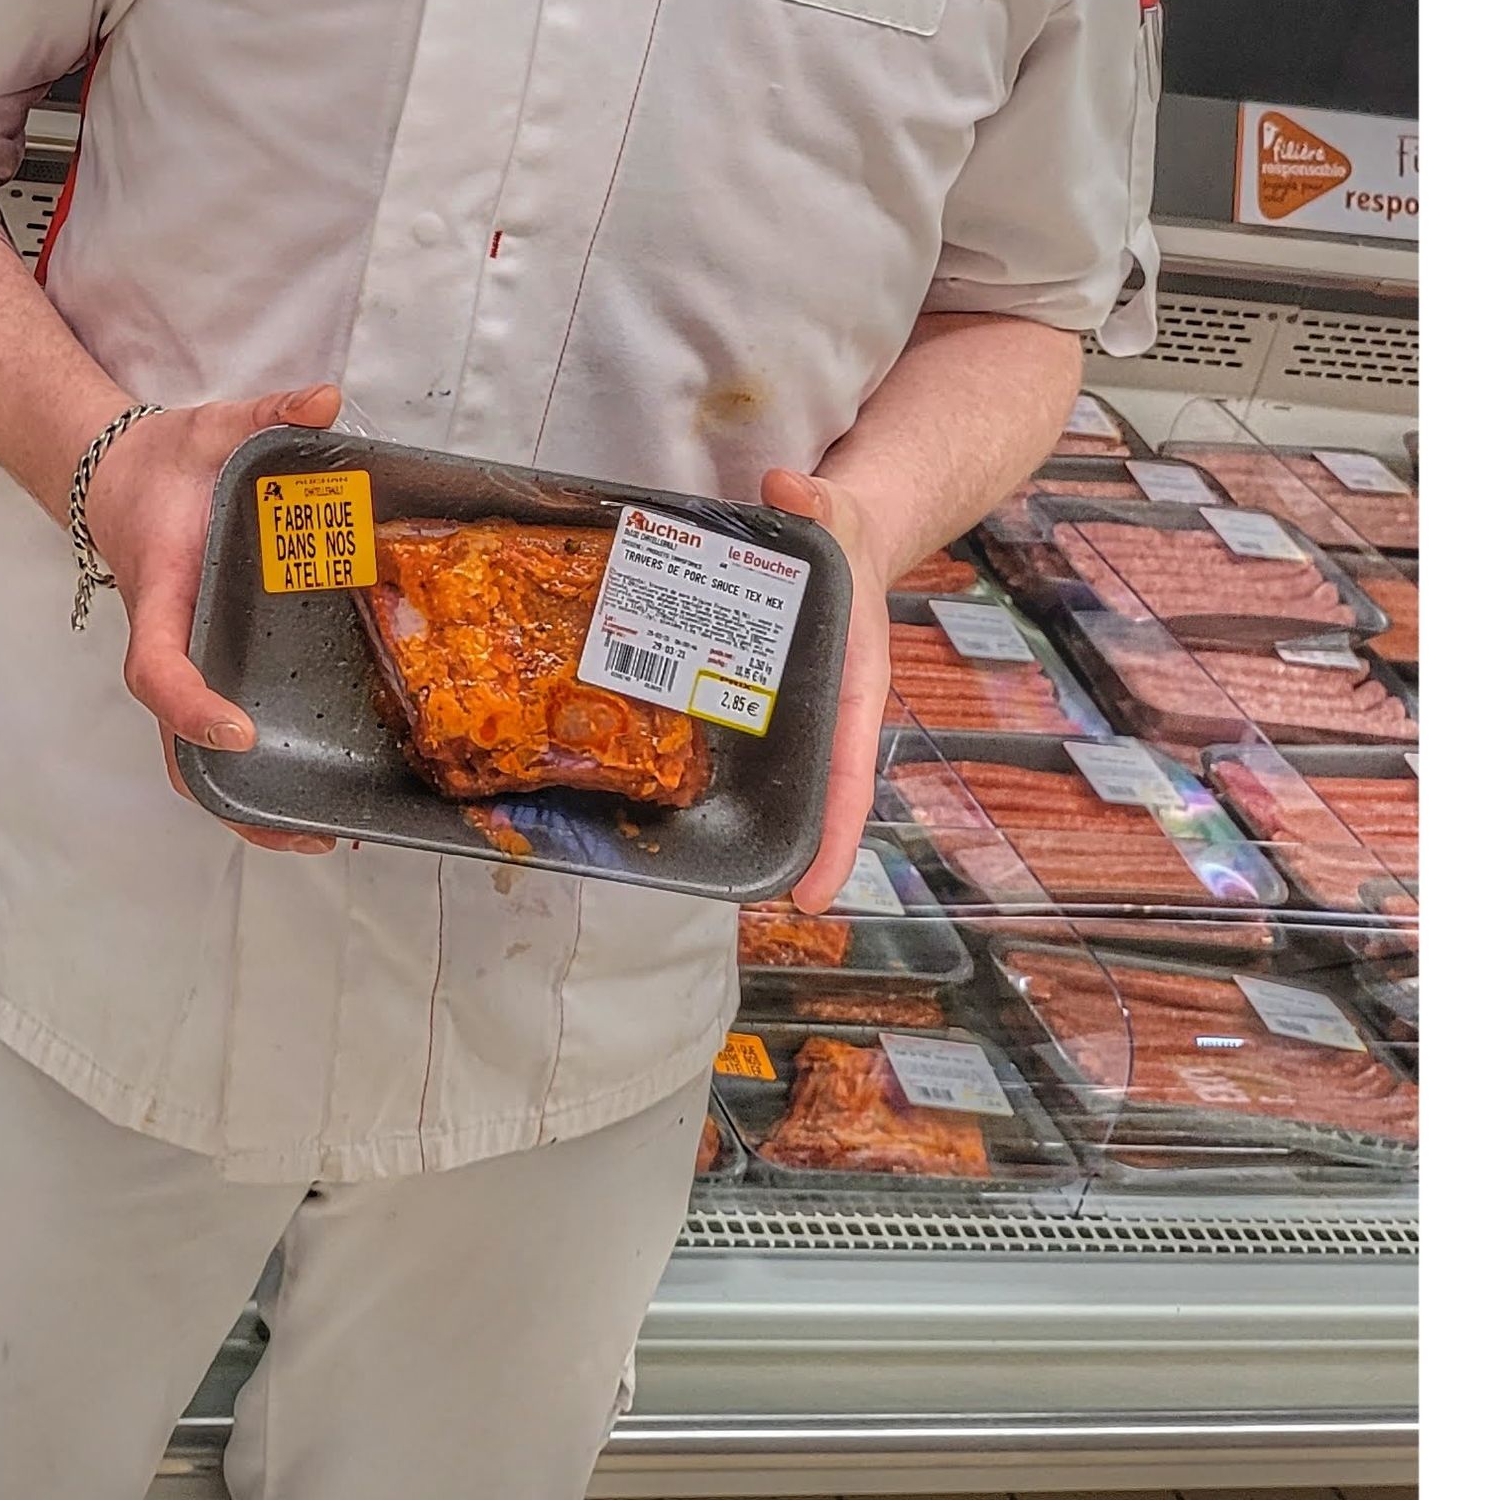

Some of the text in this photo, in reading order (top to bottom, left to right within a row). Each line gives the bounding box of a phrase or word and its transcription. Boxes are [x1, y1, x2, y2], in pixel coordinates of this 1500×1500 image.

[1262, 163, 1347, 179] responsable
[1345, 189, 1419, 221] respo
[273, 501, 354, 532] FABRIQUE
[625, 510, 702, 549] Auchan
[276, 530, 356, 561] DANS NOS
[285, 559, 354, 589] ATELIER
[728, 545, 741, 561] le
[743, 550, 802, 579] Boucher
[624, 549, 784, 610] TRAVERS DE PORC SAUCE TEX MEX
